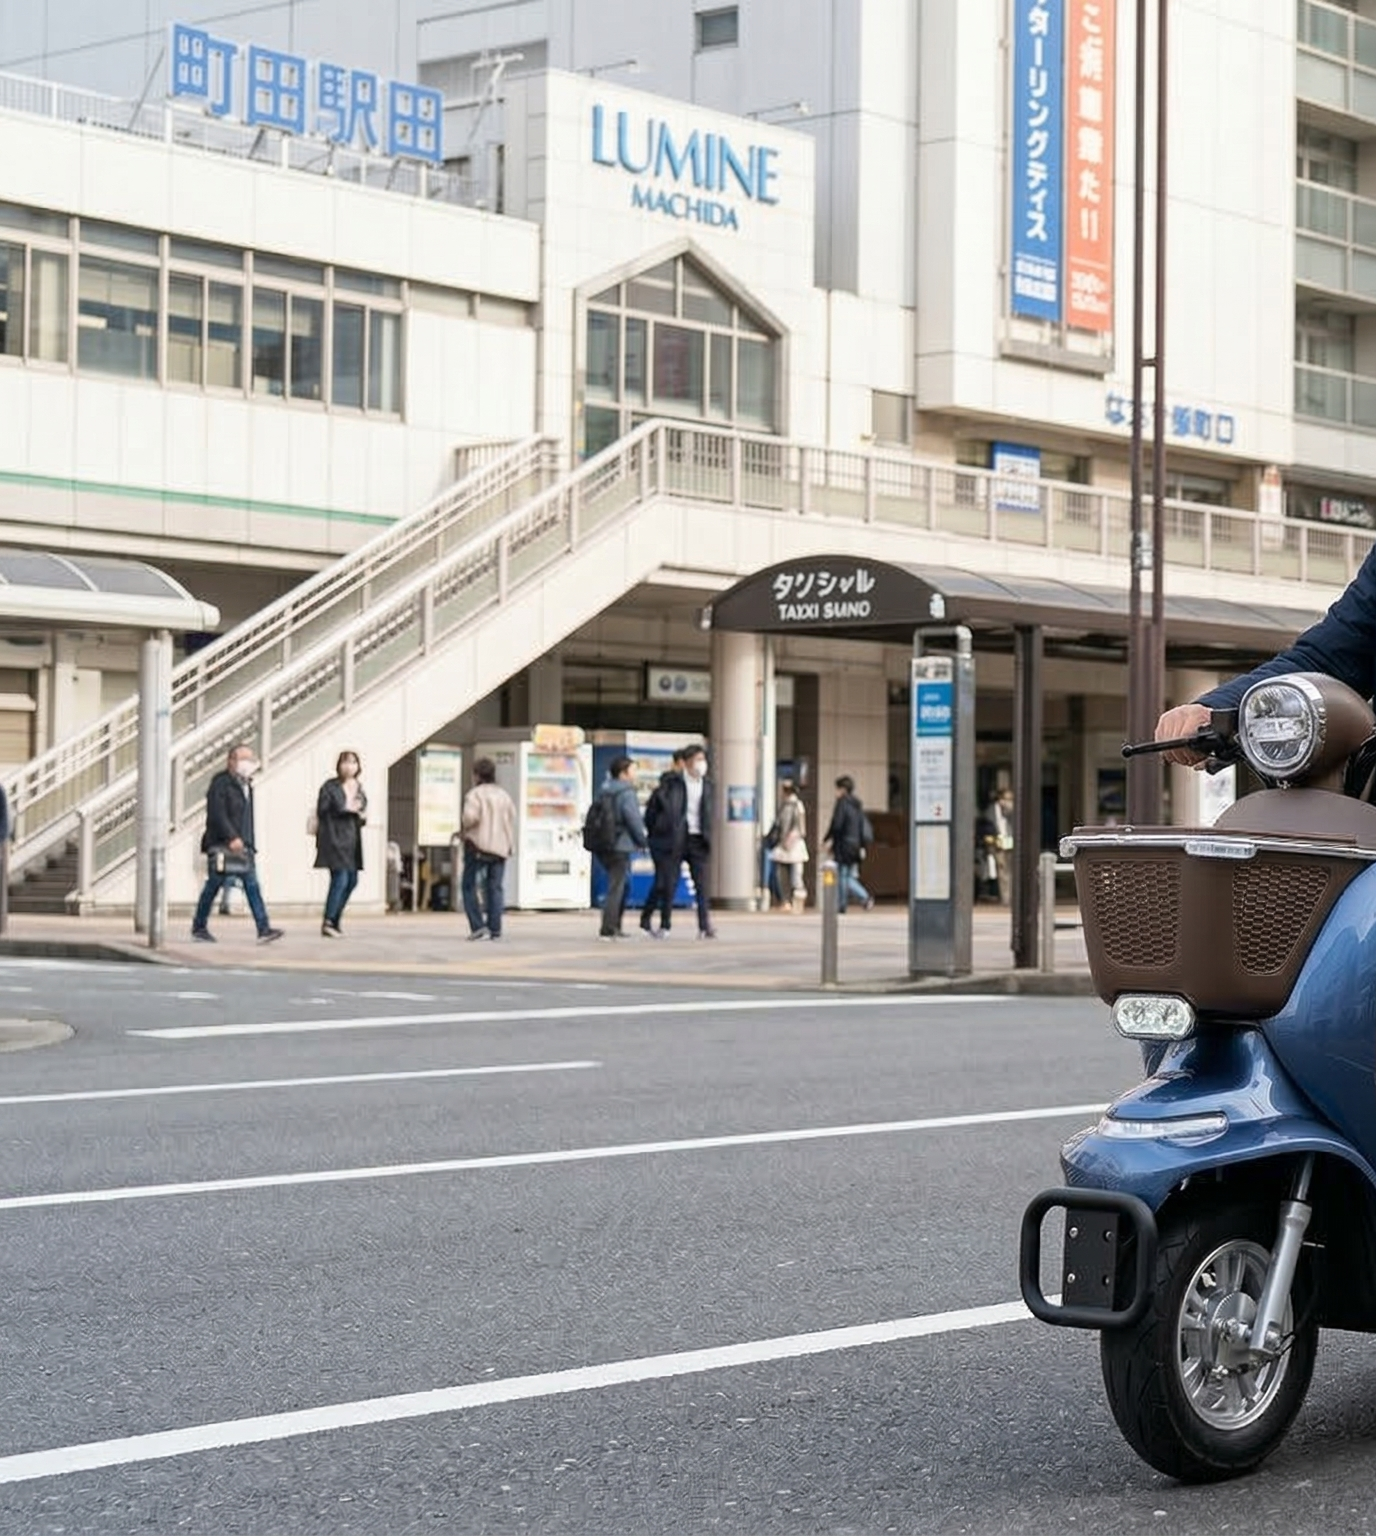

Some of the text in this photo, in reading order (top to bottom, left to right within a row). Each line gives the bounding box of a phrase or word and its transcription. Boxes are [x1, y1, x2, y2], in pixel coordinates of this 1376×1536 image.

[173, 23, 444, 163] 町田駅田
[592, 103, 781, 207] LUMINE
[631, 182, 740, 232] MACHIDA
